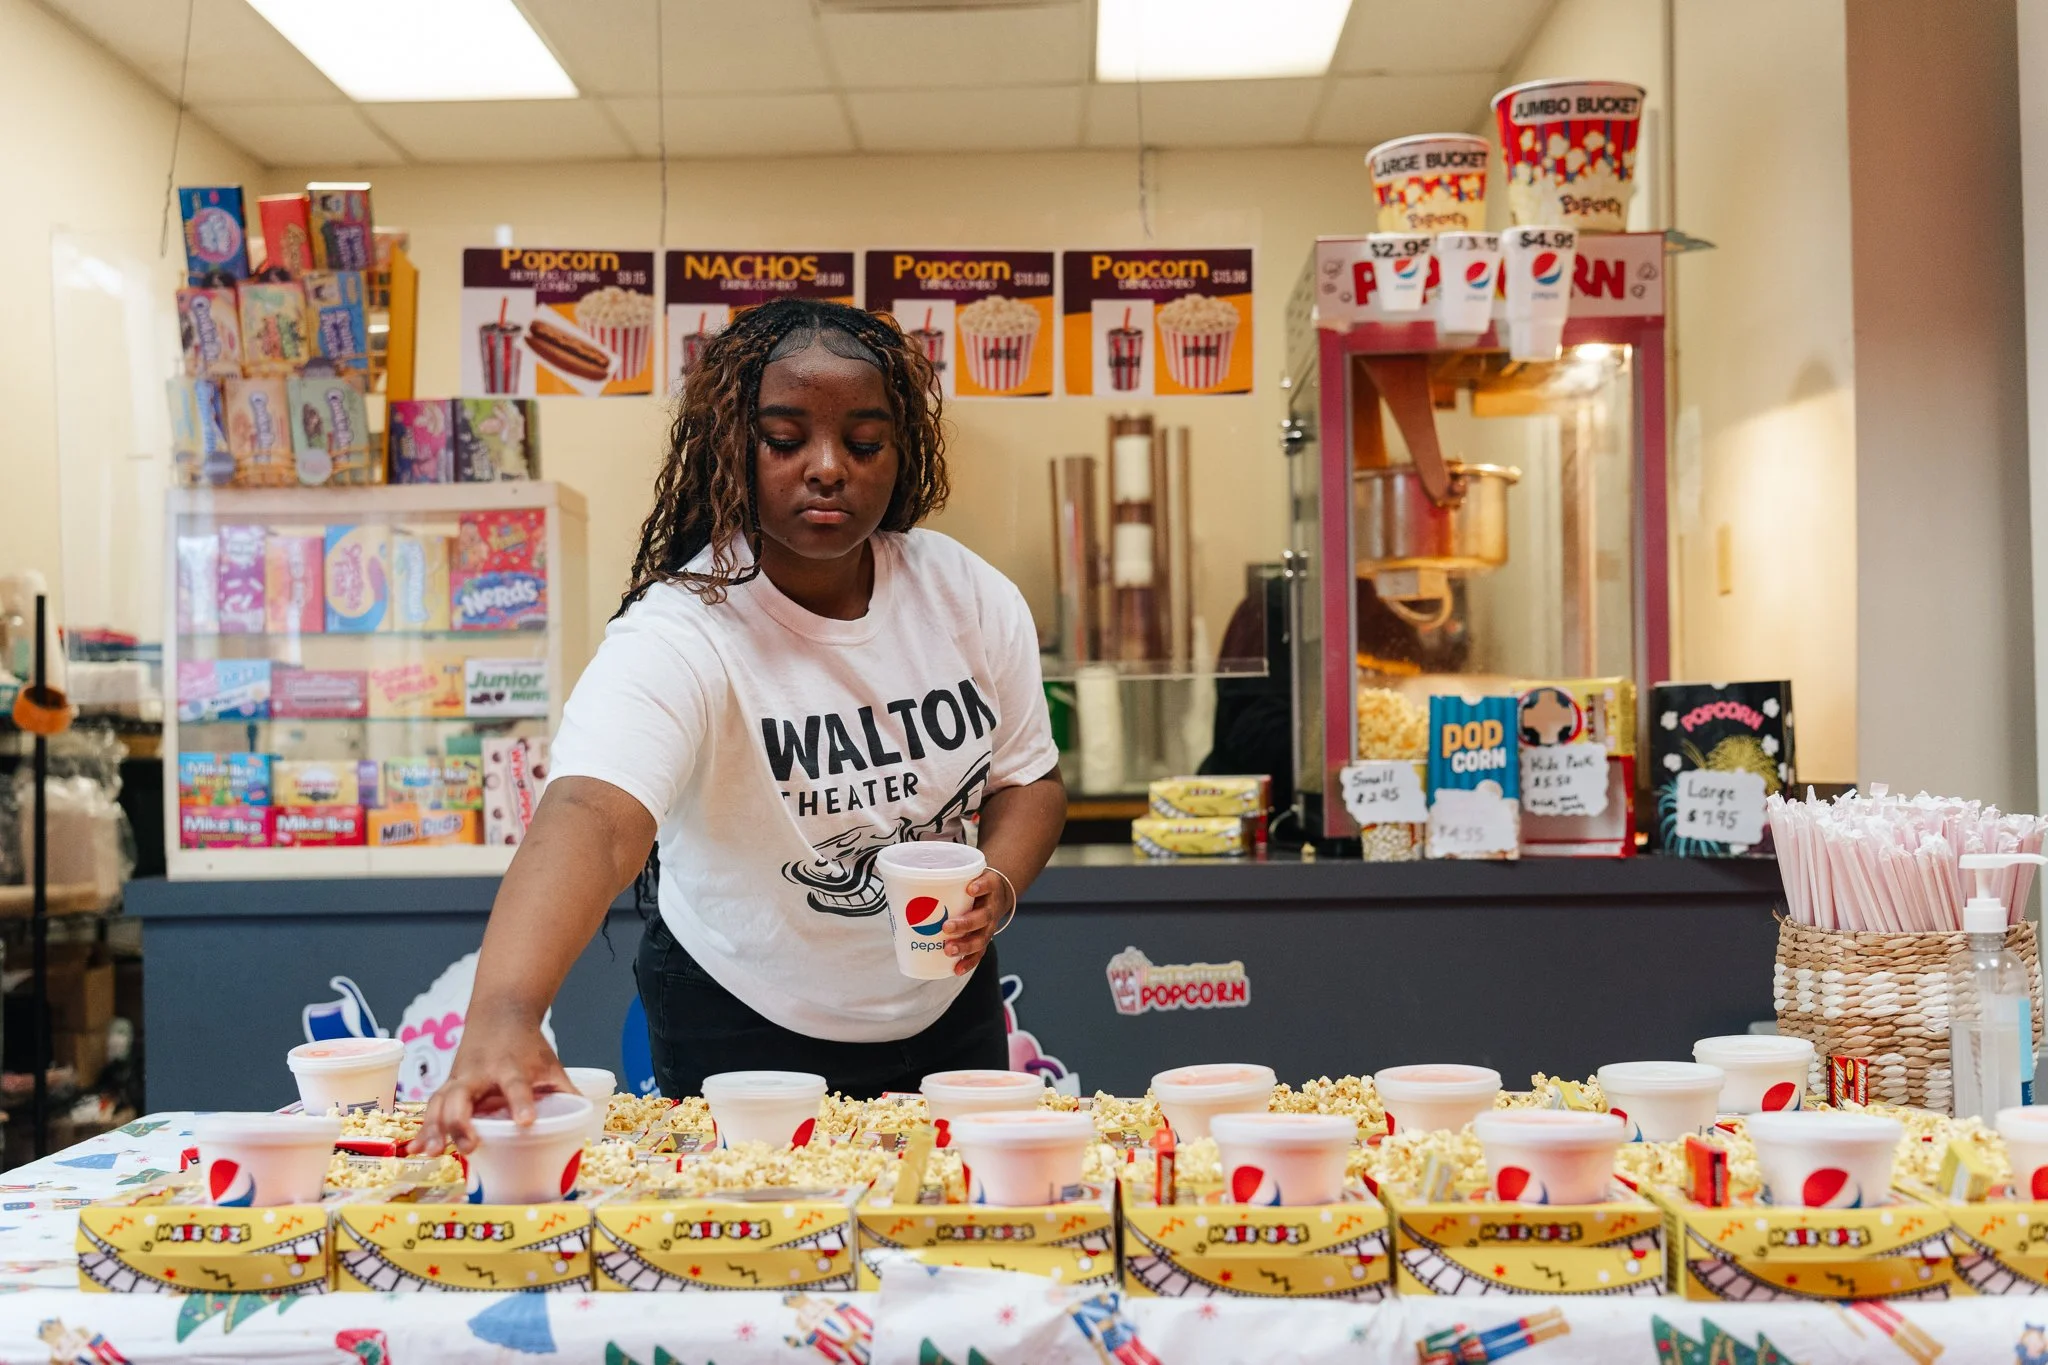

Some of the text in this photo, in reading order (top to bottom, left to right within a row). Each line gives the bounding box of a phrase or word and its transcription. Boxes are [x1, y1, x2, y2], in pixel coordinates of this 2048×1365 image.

[1514, 97, 1637, 118] JUMBO BUCKET
[1425, 151, 1486, 168] BUCKET
[1520, 231, 1573, 249] $4.95
[501, 249, 620, 273] Popcorn
[684, 254, 818, 281] NACHOS
[893, 255, 1011, 281] Popcorn
[1091, 255, 1209, 281] Popcorn
[462, 581, 538, 616] Nerds
[469, 671, 543, 689] Junior
[1680, 701, 1764, 732] POPCORN
[761, 677, 997, 781] WALTON
[1442, 719, 1503, 758] POP
[1452, 747, 1506, 773] CORN
[1352, 769, 1395, 788] Small
[1688, 780, 1735, 806] Large
[183, 815, 262, 834] Mike Ike
[277, 815, 355, 832] Mike Ike
[382, 823, 416, 842] Milk
[1141, 979, 1246, 1007] POPCORN
[205, 1223, 251, 1243] CRAZE
[467, 1221, 514, 1242] CRAZE
[723, 1220, 771, 1241] CRAZE
[986, 1222, 1035, 1241] CRAZE
[1260, 1223, 1309, 1245] CRAZE
[1532, 1221, 1583, 1242] CRAZE
[1821, 1226, 1872, 1248] CRAZE
